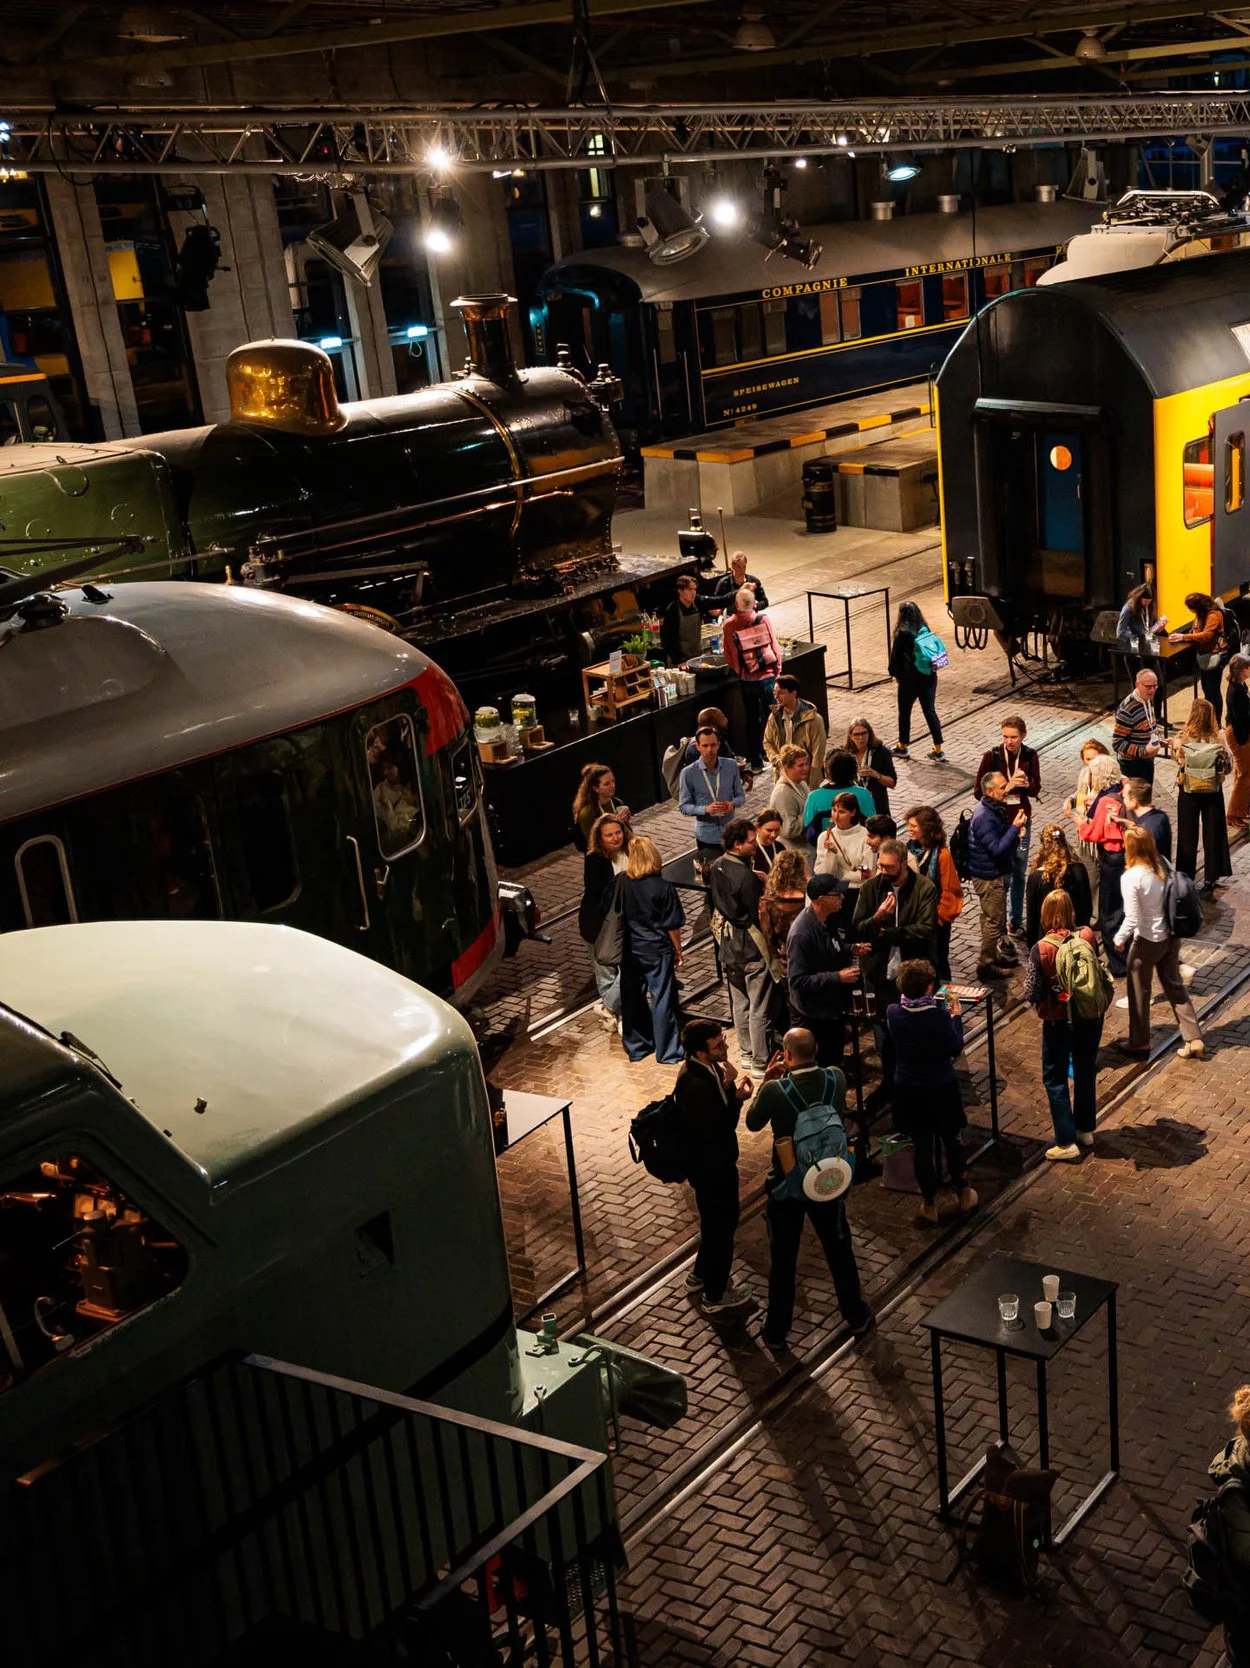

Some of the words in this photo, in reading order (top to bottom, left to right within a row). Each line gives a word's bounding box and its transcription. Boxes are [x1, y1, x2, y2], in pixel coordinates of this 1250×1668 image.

[761, 277, 848, 298] COMPAGNIE
[904, 251, 1012, 277] INTERNATIONALE
[732, 376, 800, 397] SPEISEWAGEN
